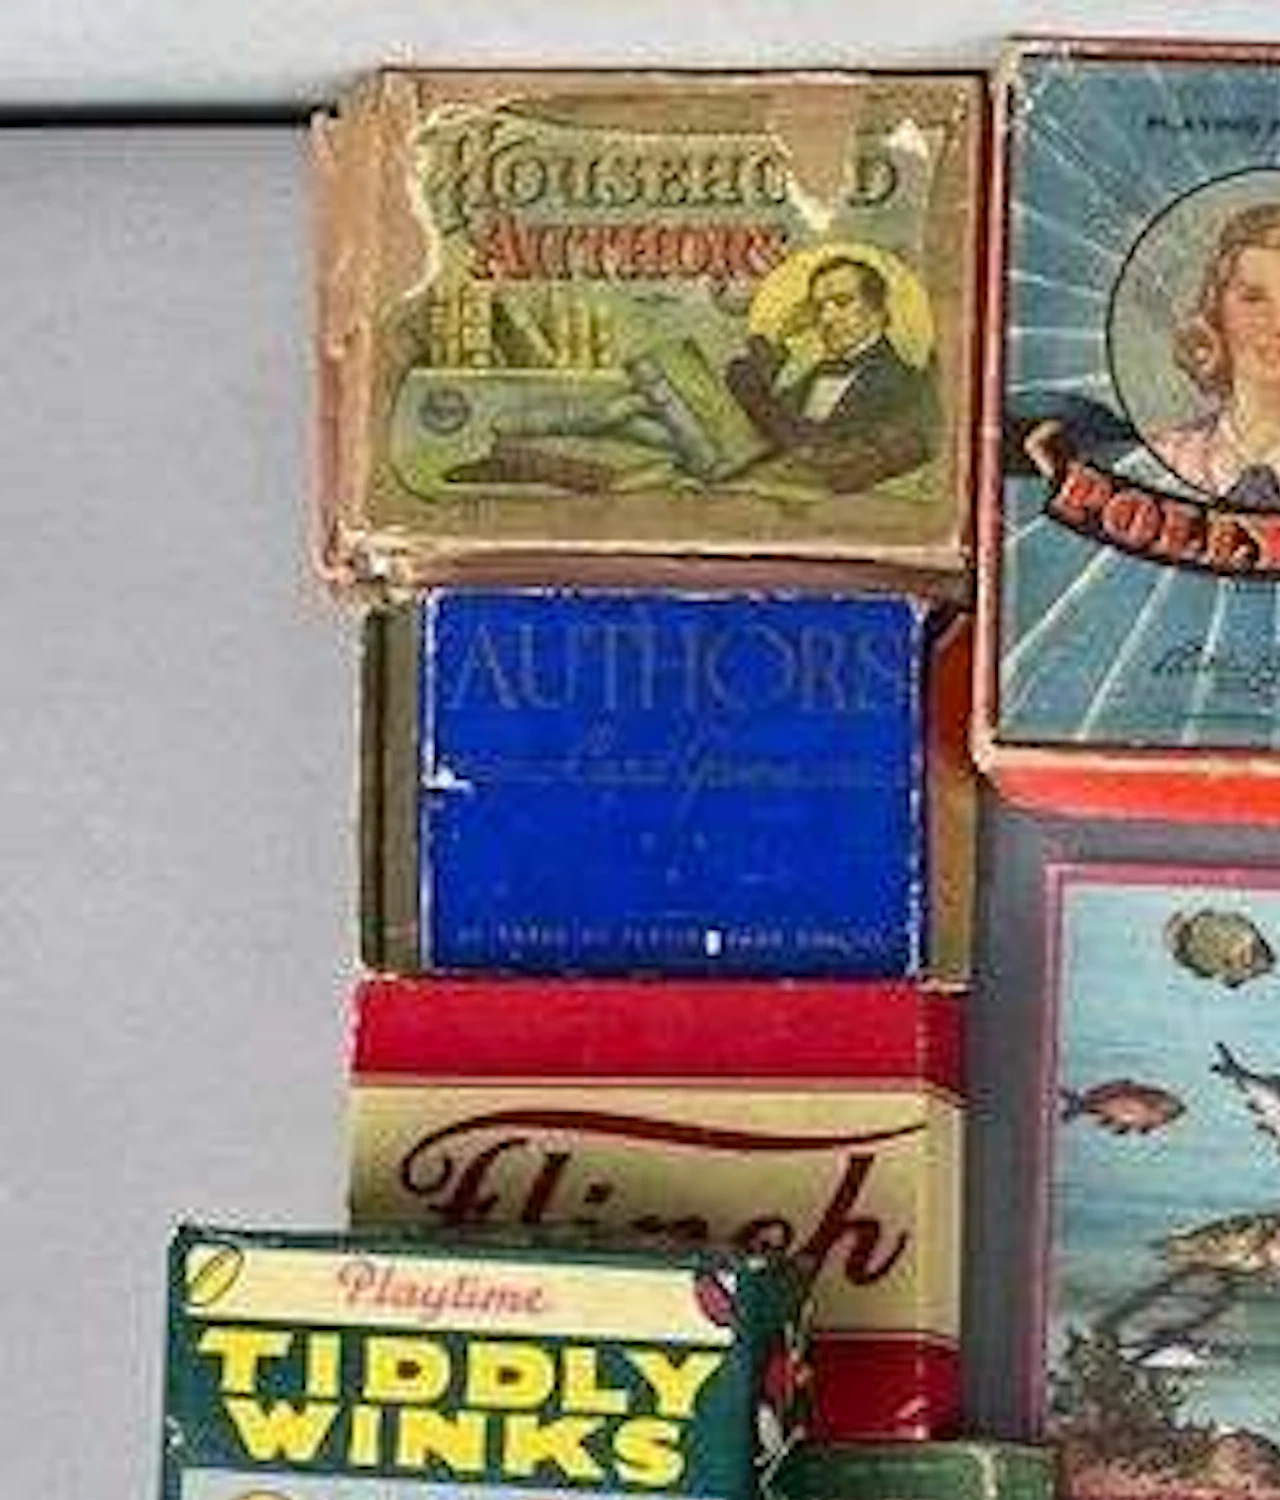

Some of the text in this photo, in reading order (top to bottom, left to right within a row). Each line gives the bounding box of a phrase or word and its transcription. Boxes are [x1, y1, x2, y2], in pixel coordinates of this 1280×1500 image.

[432, 125, 900, 210] HOUSEHOD
[470, 222, 790, 283] AUTHORS
[443, 620, 905, 710] AUTHORS
[335, 1260, 549, 1323] Playtime
[199, 1324, 730, 1420] TIDDLY
[225, 1398, 689, 1489] WINKS
